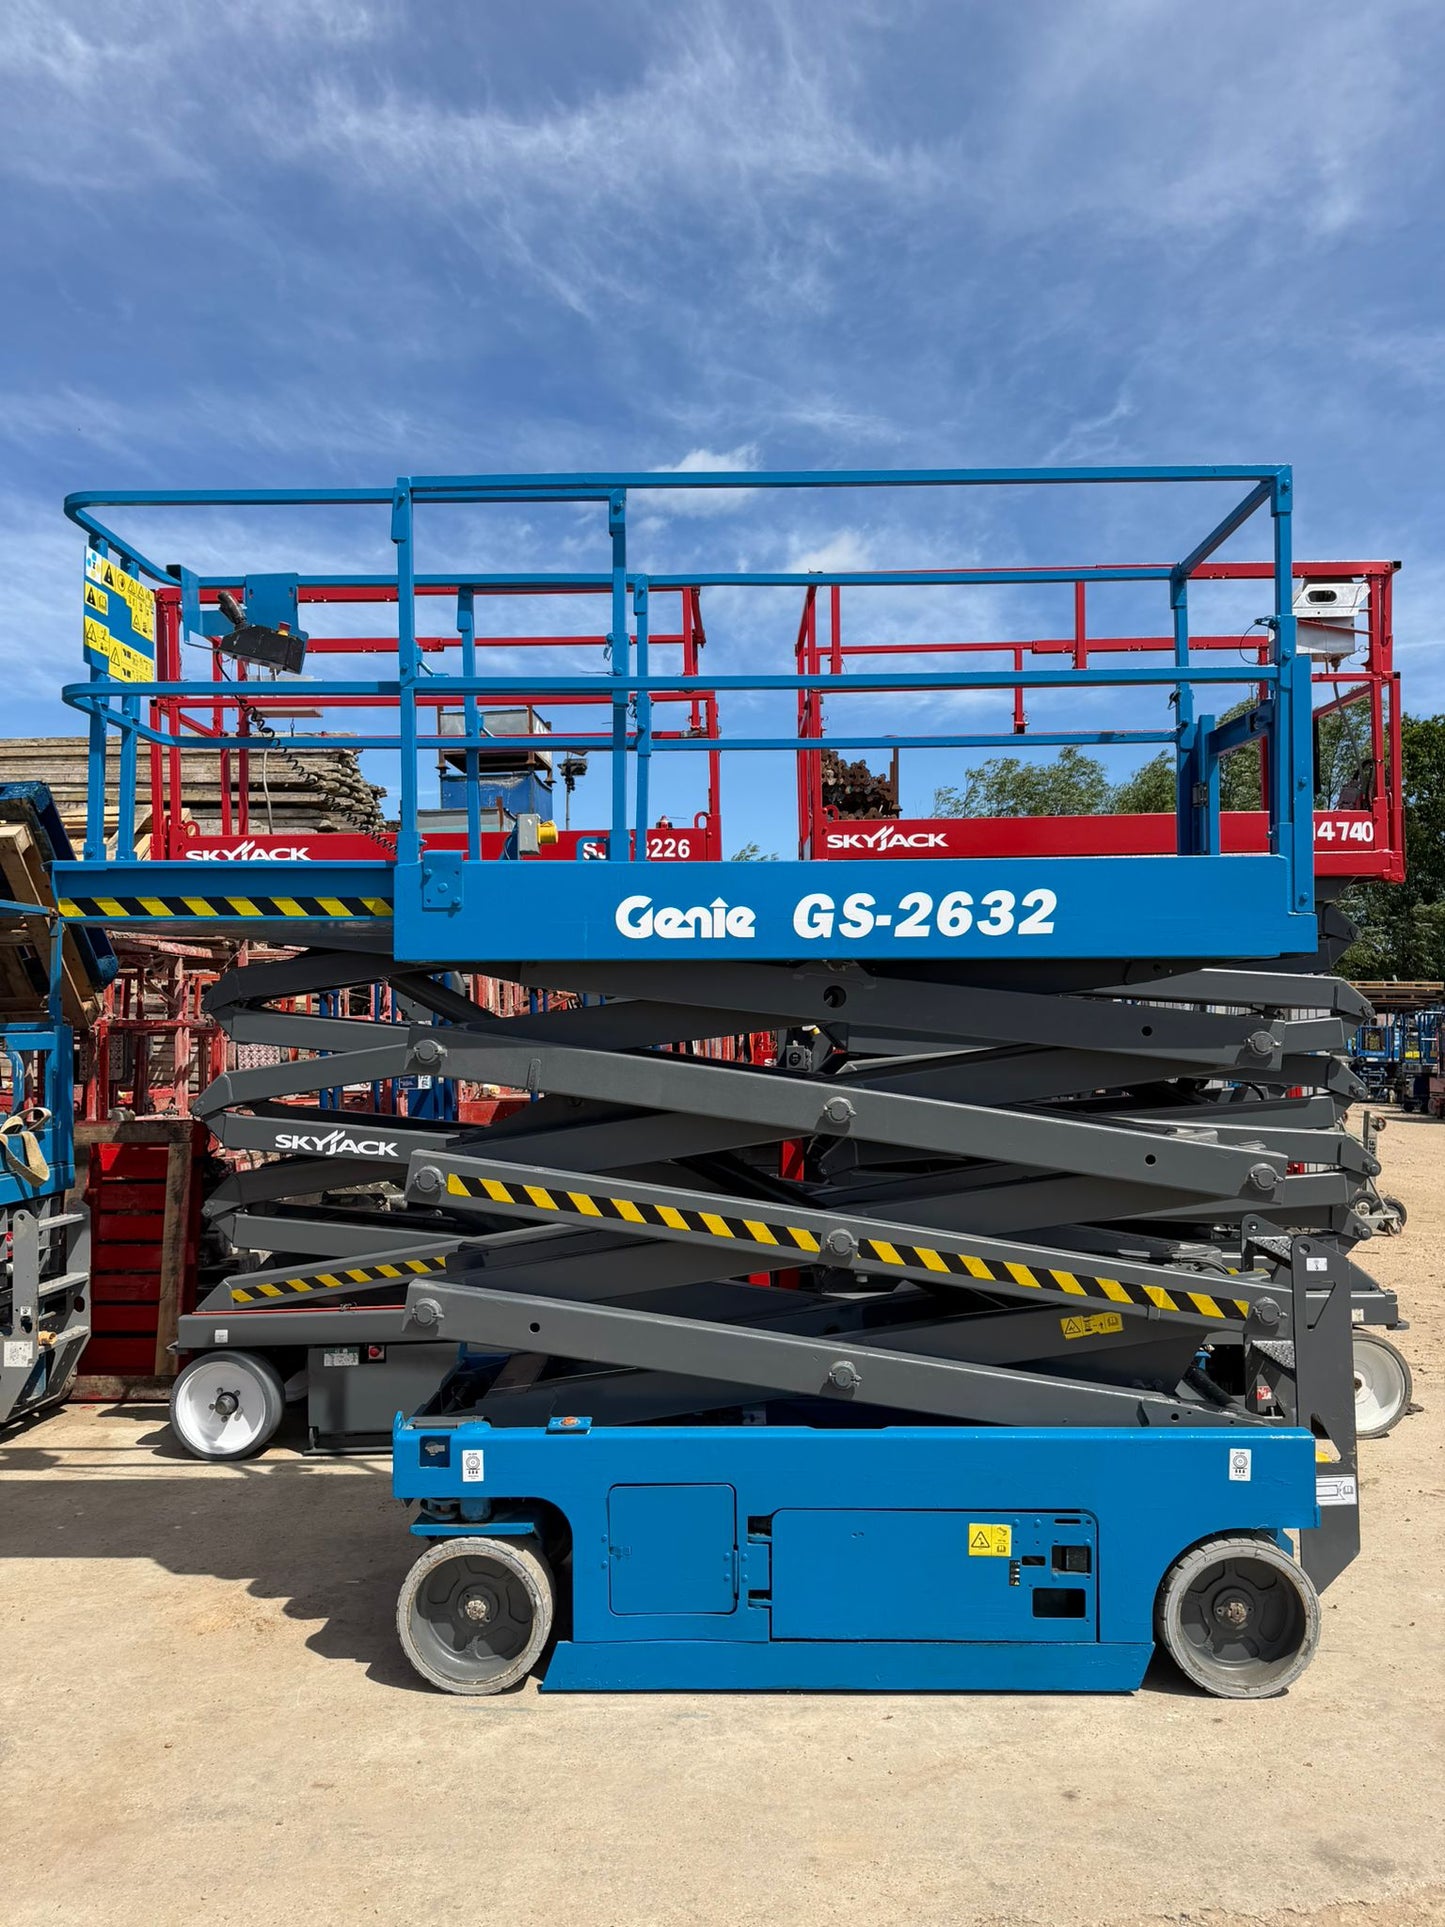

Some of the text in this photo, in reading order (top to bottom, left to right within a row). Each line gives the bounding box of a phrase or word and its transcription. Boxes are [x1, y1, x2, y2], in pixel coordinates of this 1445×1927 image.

[185, 840, 313, 861] SKYJACK
[646, 838, 690, 858] 226
[827, 825, 950, 852] SKYJACK
[615, 888, 1058, 939] Genie GS-2632
[275, 1130, 399, 1157] SKYJACK
